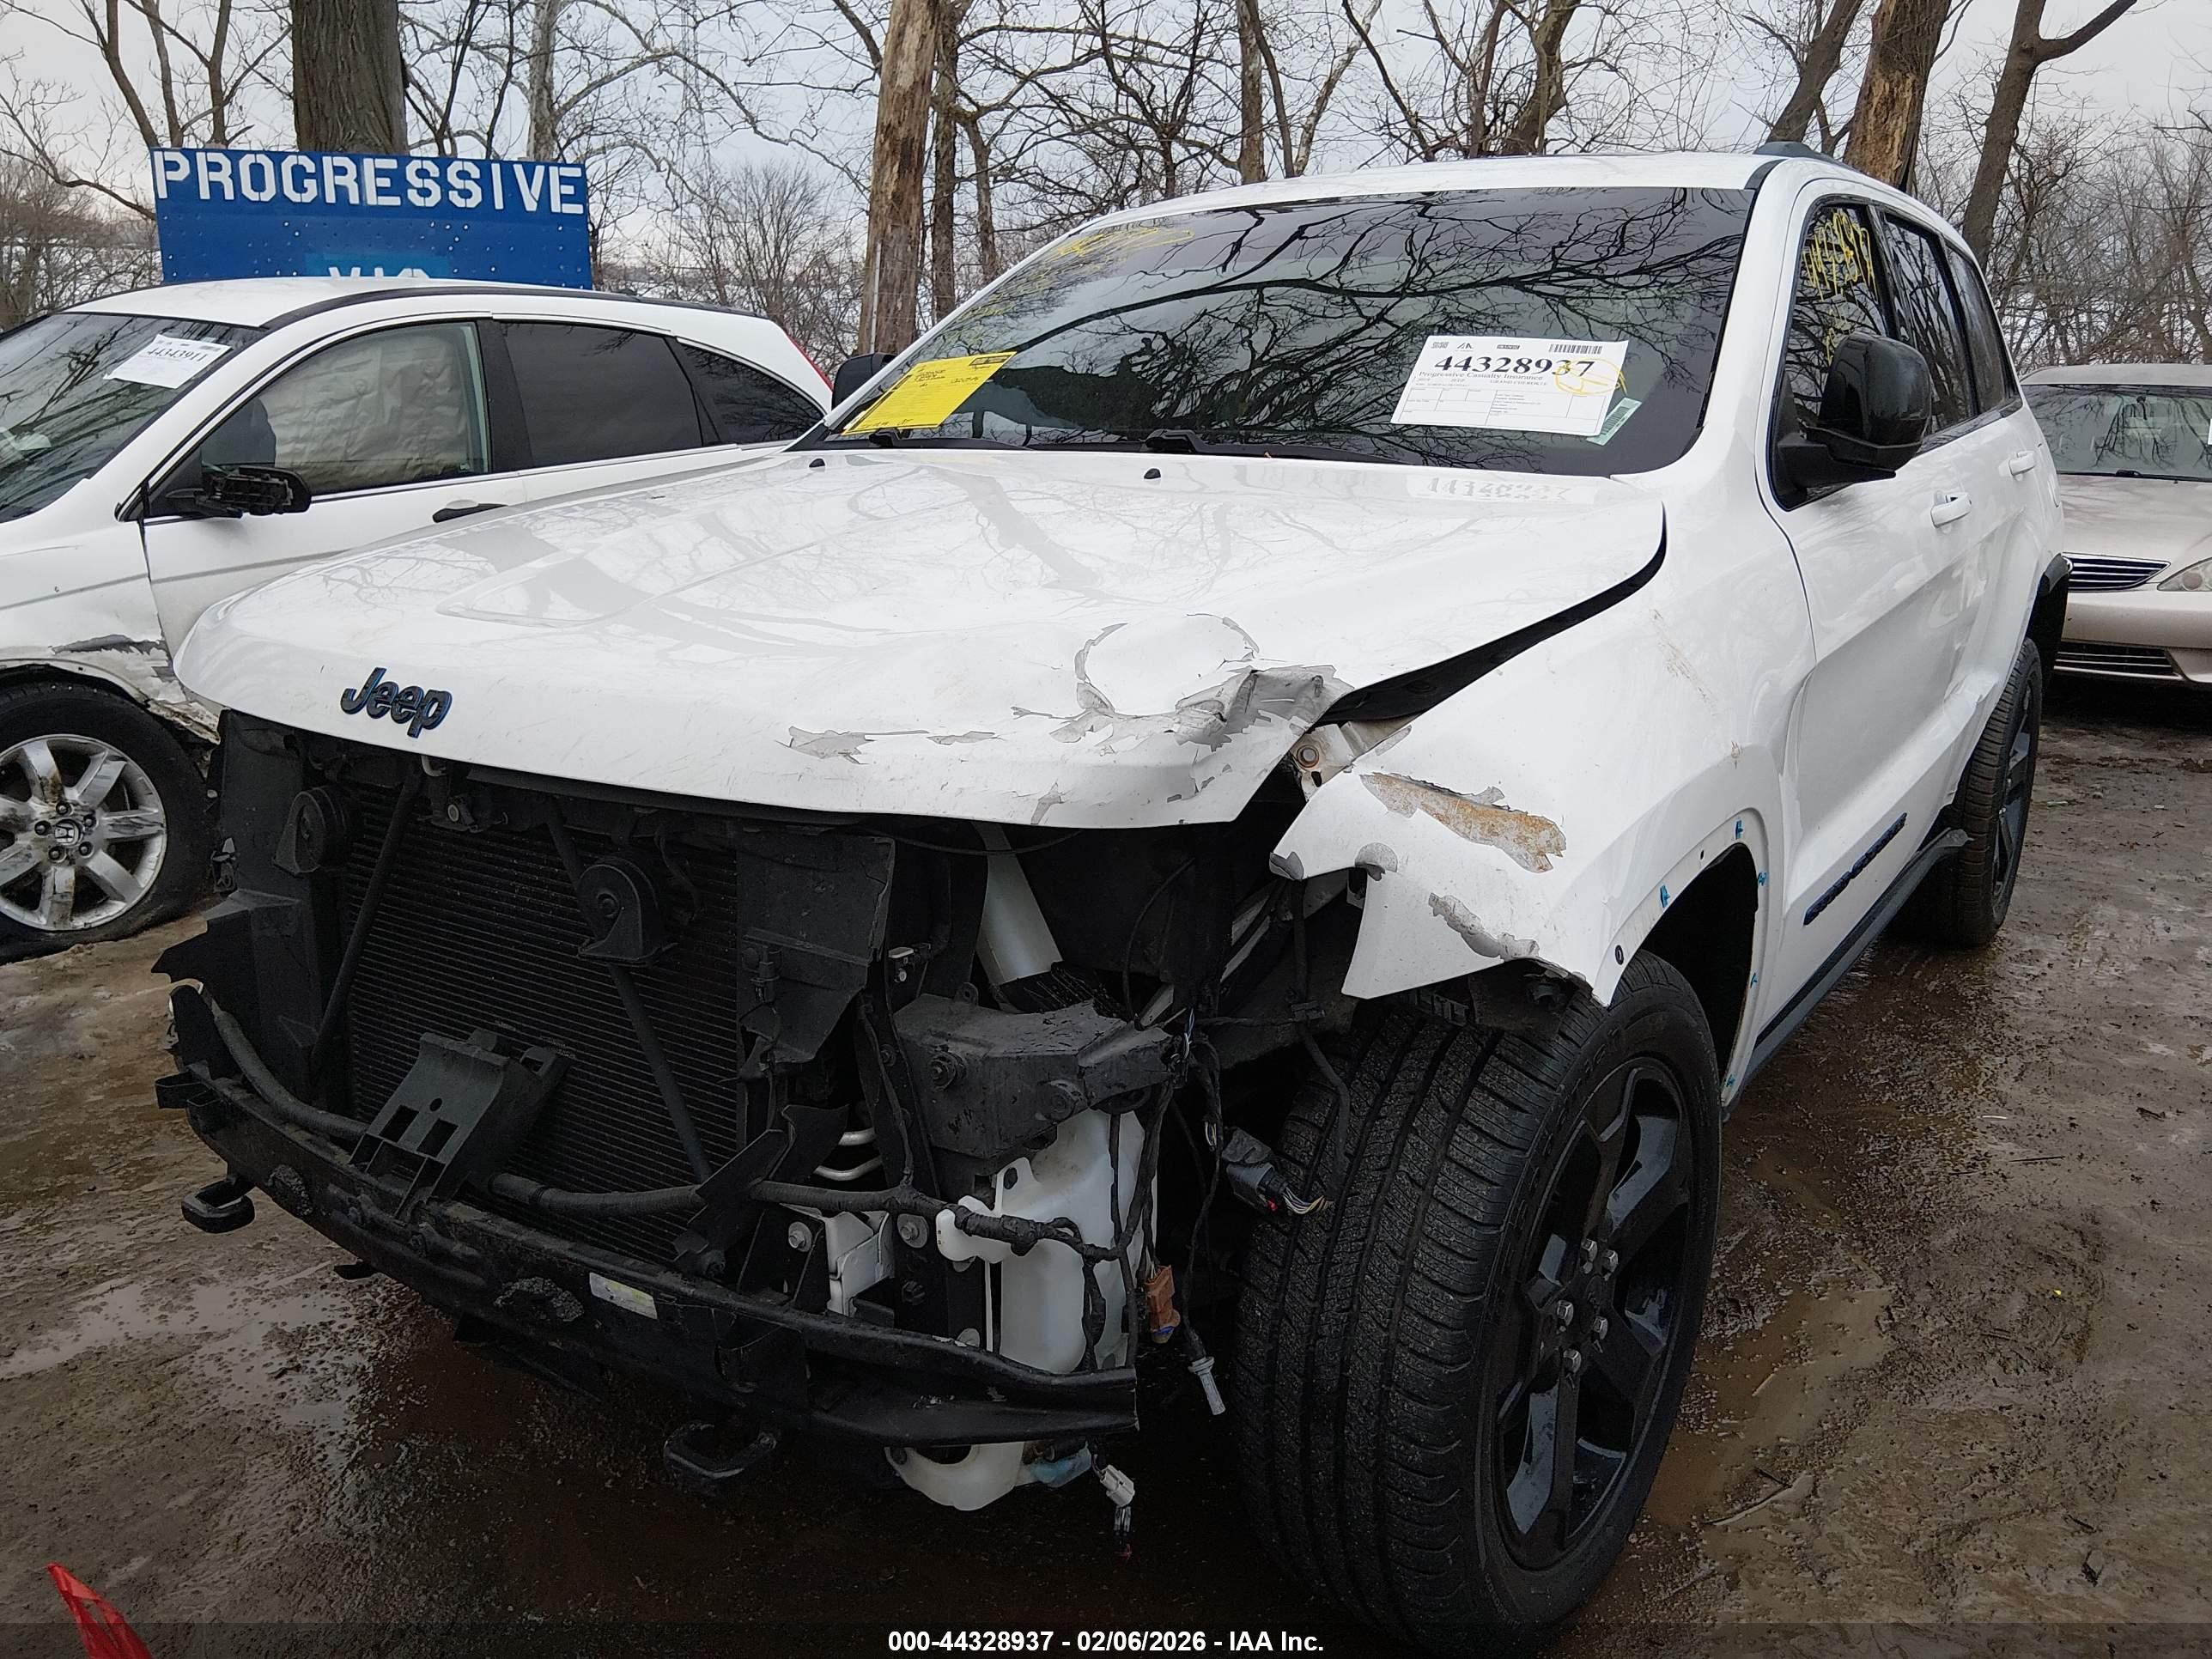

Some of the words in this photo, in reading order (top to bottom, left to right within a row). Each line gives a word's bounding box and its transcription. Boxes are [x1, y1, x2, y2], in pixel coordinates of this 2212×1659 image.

[153, 150, 585, 215] PROGRESSIVE
[1434, 356, 1595, 377] 44328937
[340, 666, 453, 738] Jeep
